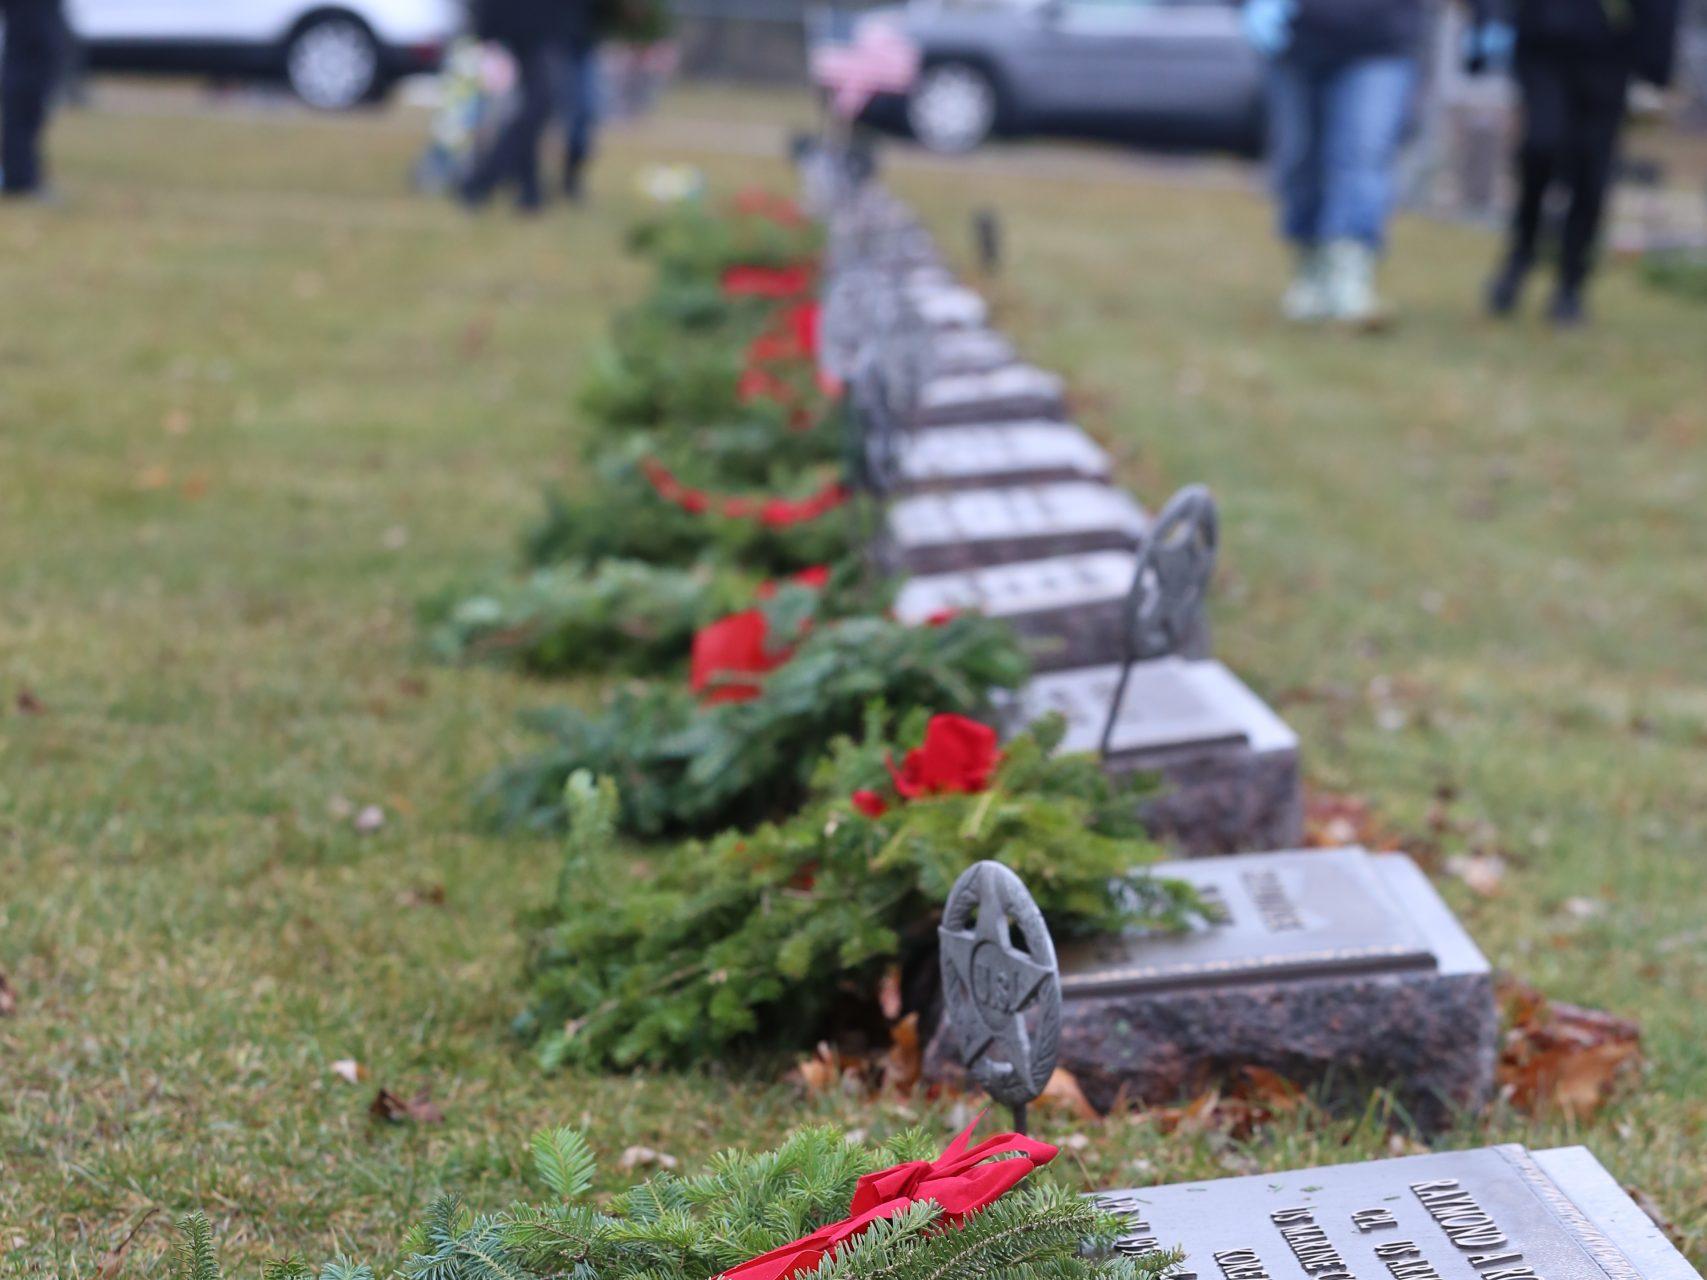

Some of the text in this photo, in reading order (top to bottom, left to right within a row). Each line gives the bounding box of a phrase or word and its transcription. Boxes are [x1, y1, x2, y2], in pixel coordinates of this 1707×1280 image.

[1270, 1208, 1313, 1225] US
[1352, 1208, 1398, 1232] CPL
[1375, 1239, 1420, 1259] US
[1410, 1179, 1507, 1249] RAYMOND
[1467, 1253, 1523, 1269] A
[1114, 1236, 1160, 1257] 193
[1281, 1223, 1346, 1275] MARINE
